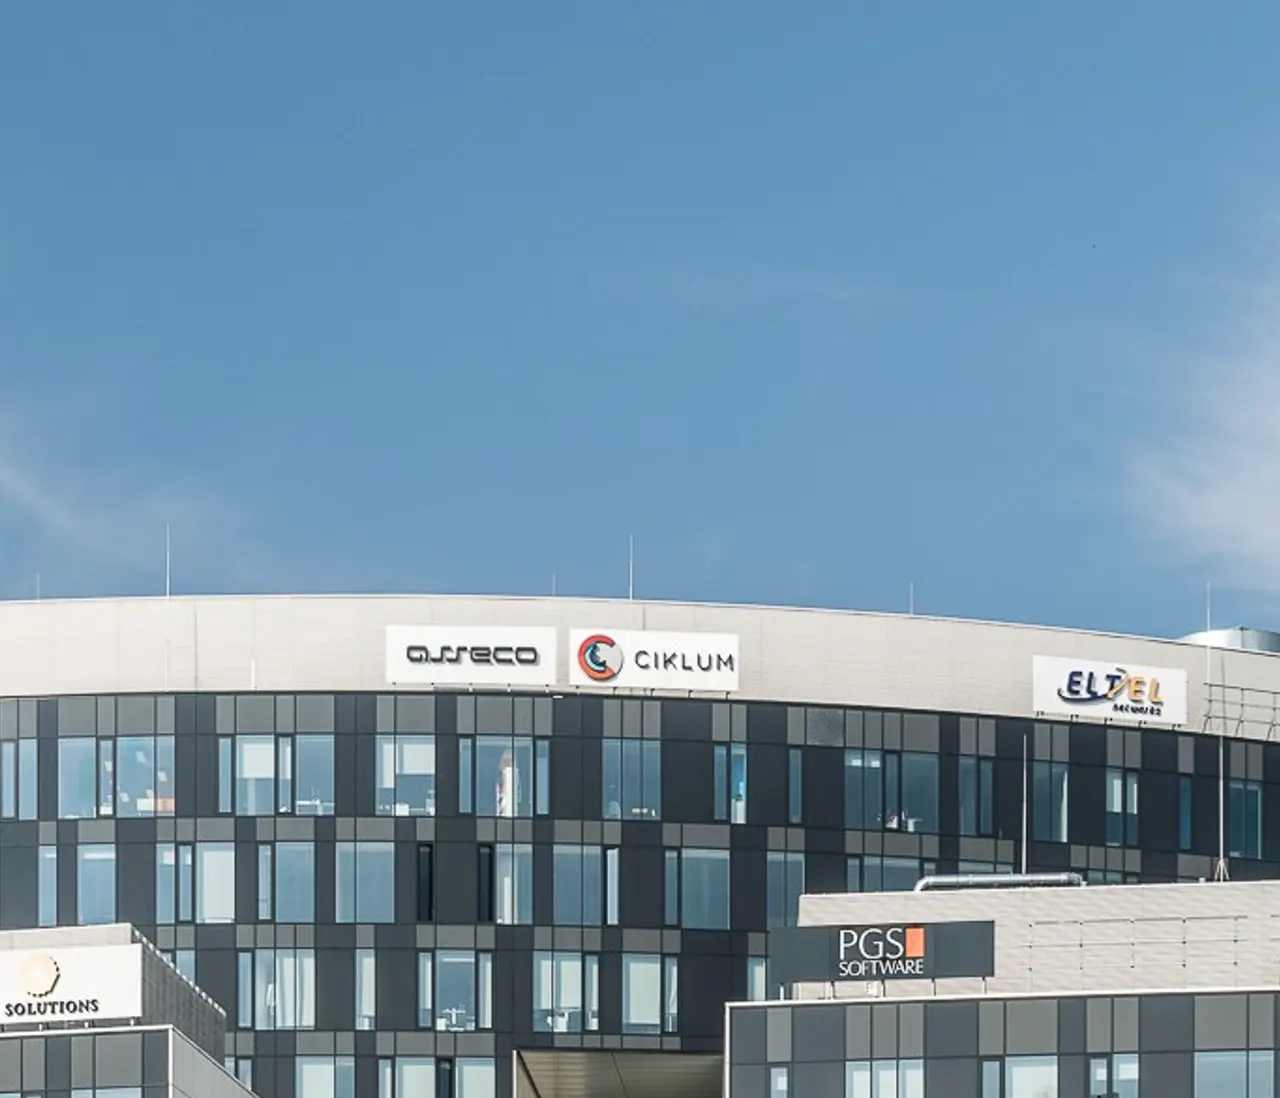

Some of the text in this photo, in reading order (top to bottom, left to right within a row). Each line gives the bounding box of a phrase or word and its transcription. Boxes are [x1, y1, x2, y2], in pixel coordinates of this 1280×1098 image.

[406, 644, 540, 665] asseco
[634, 650, 735, 672] CIKLUM
[839, 927, 905, 960] PGS
[839, 959, 924, 977] SOFTWARE
[4, 998, 100, 1017] SOLUTIONS
